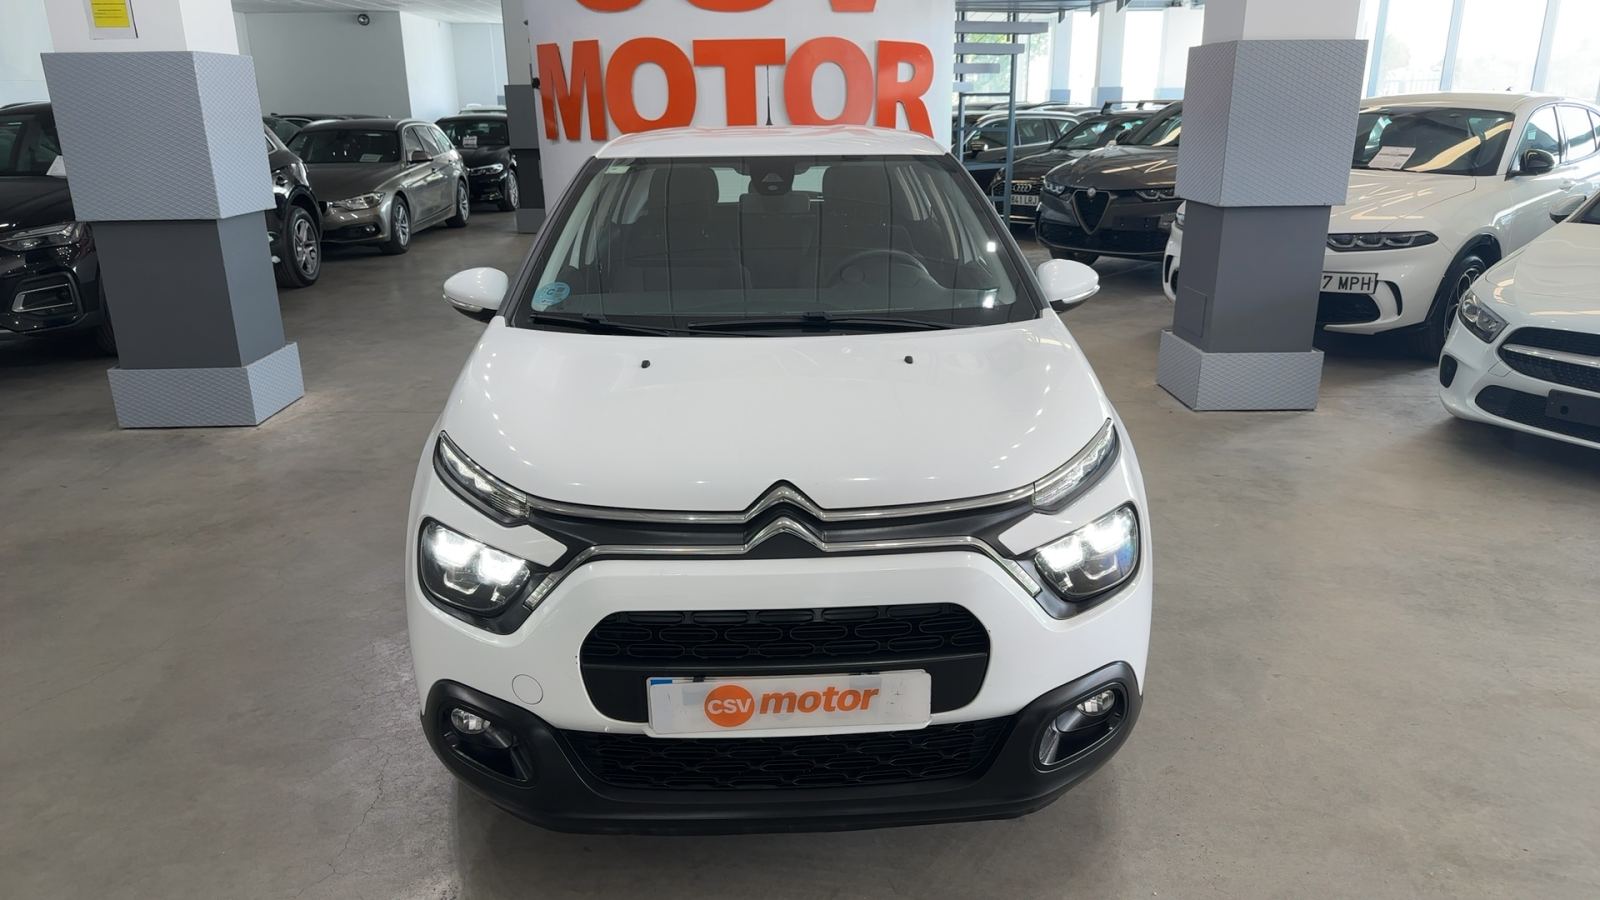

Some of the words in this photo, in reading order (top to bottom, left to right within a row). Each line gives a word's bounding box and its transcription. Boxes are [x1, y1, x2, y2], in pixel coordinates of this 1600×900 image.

[537, 36, 935, 141] MOTOR
[1338, 276, 1371, 291] MPH
[759, 686, 879, 715] motor
